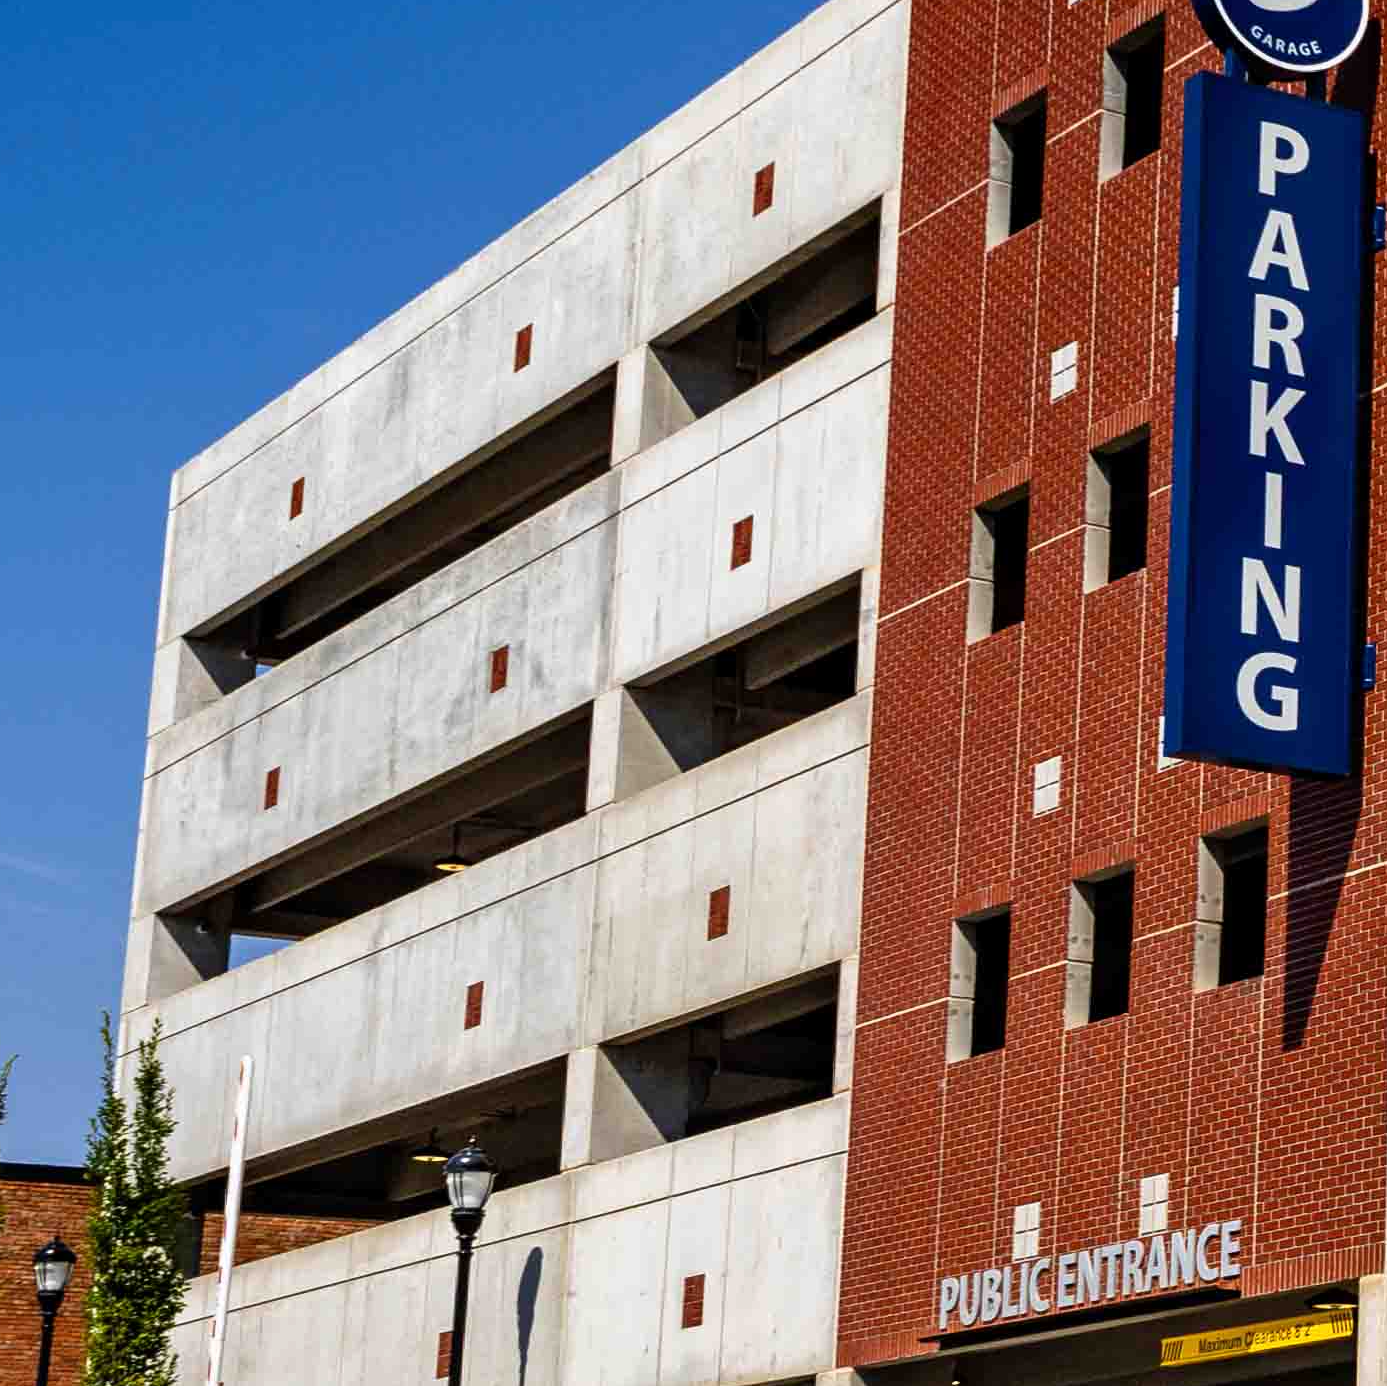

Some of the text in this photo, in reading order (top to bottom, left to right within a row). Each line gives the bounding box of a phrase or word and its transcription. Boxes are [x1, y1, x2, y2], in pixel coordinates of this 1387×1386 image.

[1250, 24, 1322, 57] GARAGE
[1235, 121, 1311, 732] PARKING
[938, 1219, 1243, 1330] PUBLIC ENTRANCE
[1199, 1334, 1242, 1351] Maximum
